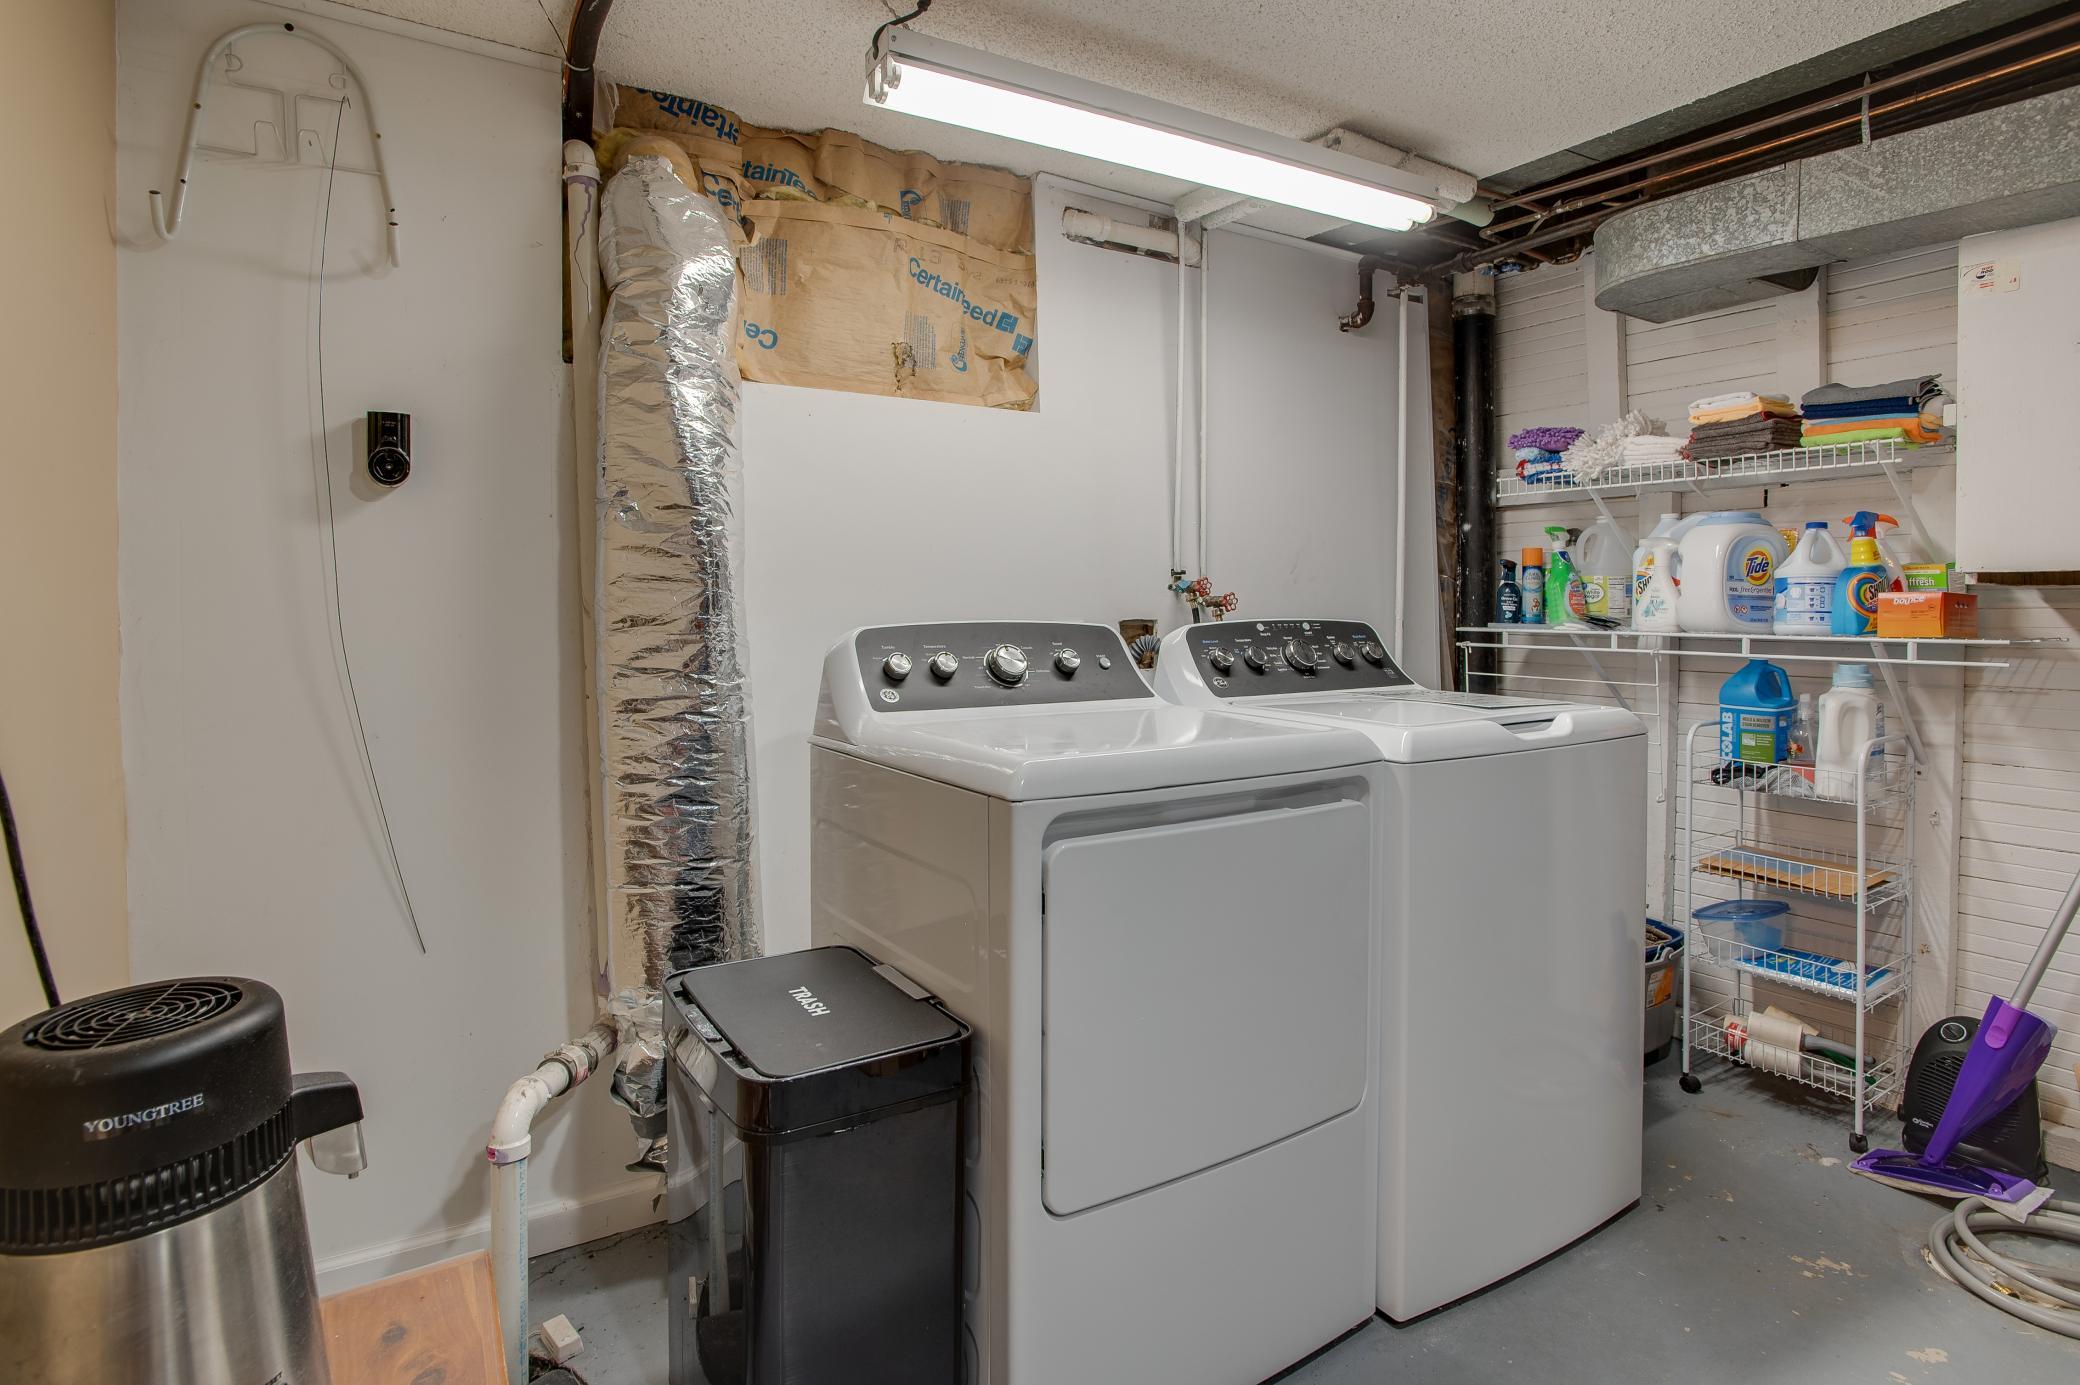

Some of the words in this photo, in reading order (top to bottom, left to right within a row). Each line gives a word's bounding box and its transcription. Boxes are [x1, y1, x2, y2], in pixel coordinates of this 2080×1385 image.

[1746, 556, 1770, 577] Tide
[788, 986, 831, 1017] TRASH
[83, 1093, 204, 1133] YOUNGTREE
